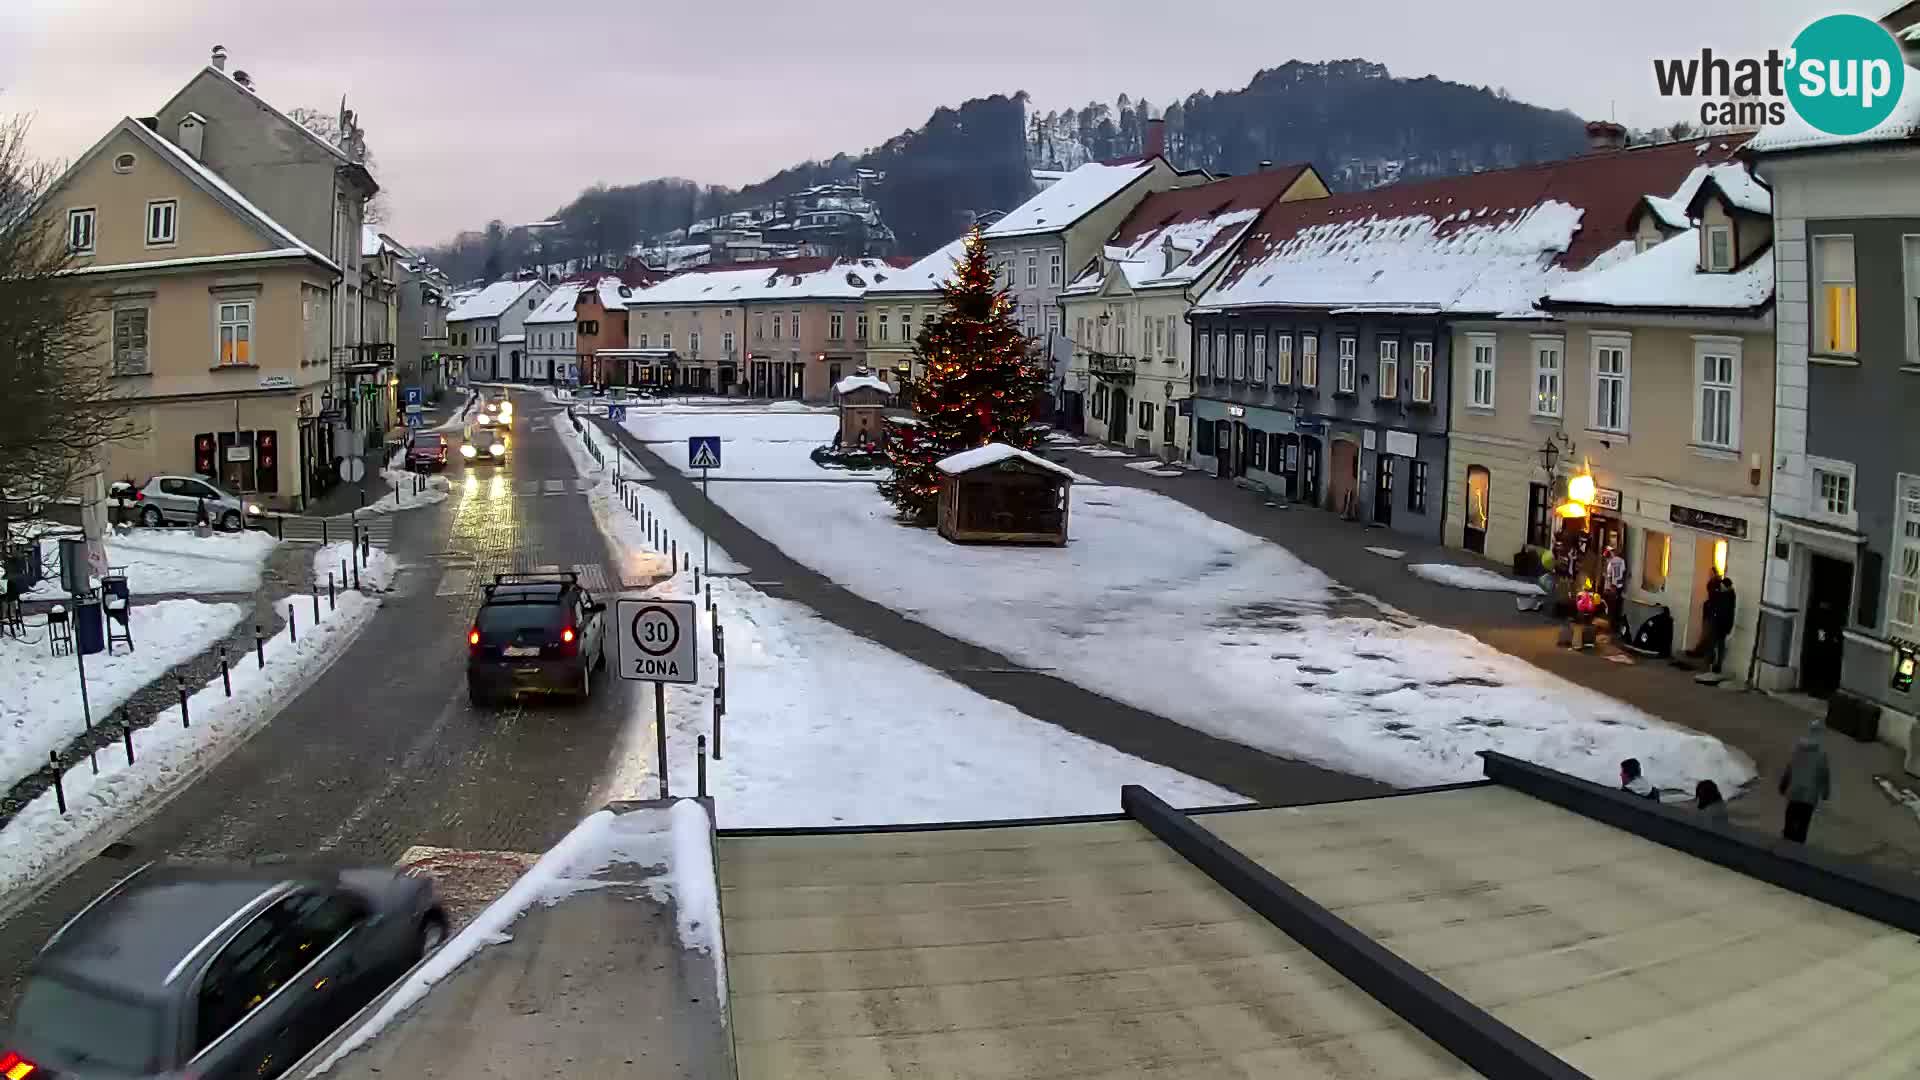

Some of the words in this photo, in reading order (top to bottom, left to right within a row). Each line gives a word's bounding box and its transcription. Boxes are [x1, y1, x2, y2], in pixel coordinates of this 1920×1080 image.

[409, 391, 417, 402] P
[644, 621, 668, 643] 30
[635, 659, 679, 676] ZONA
